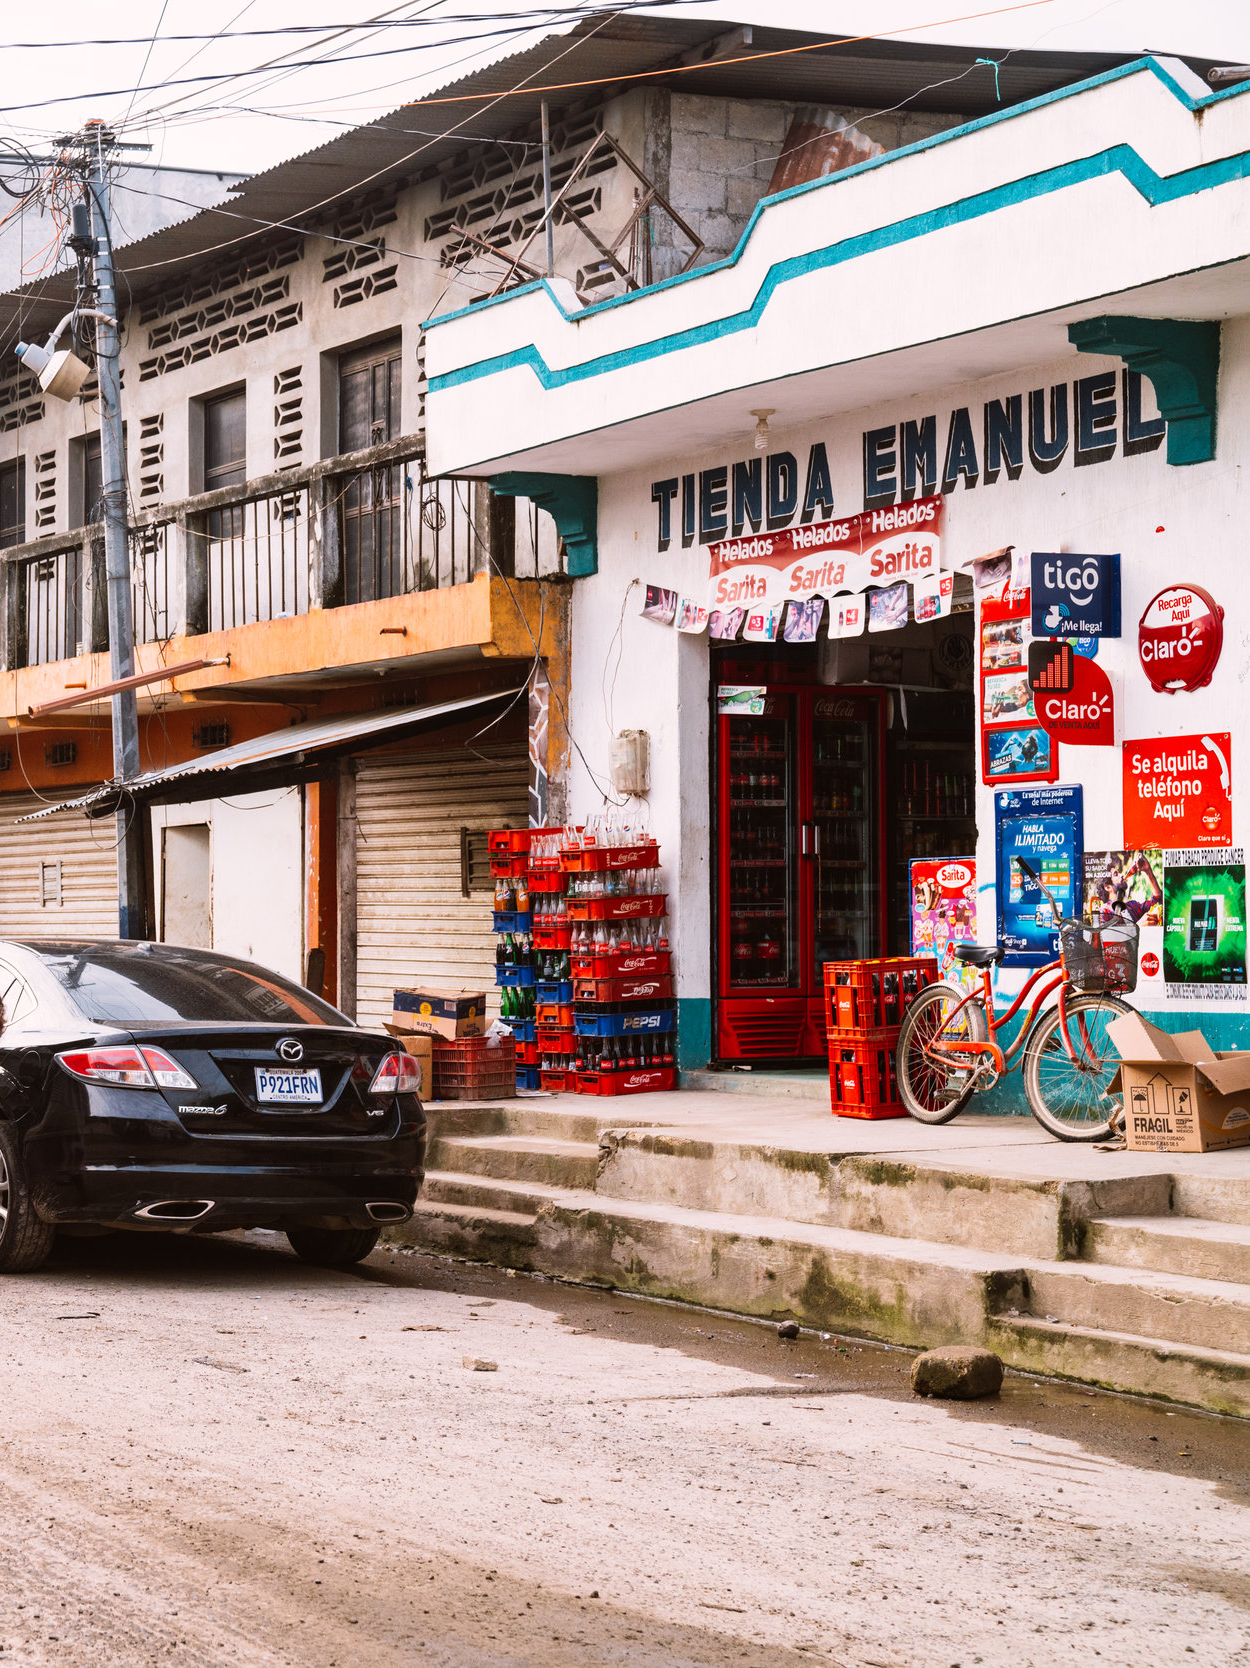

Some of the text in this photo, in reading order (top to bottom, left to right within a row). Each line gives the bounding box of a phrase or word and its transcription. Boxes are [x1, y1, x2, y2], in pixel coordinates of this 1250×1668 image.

[652, 368, 1167, 552] TIENDA EMANUEL
[719, 502, 935, 562] Helados Helados Helados
[715, 542, 933, 604] Sarita Sarita Sarita
[1043, 558, 1100, 591] tigo
[1158, 595, 1193, 612] Recarga
[1171, 606, 1191, 622] Aquí
[1061, 620, 1103, 634] ¡Me llega!
[1141, 638, 1192, 662] Claro
[1045, 699, 1101, 720] Claro
[1048, 719, 1101, 729] DE VENTA AQUÍ
[990, 754, 1012, 768] ABRAZAS
[1132, 750, 1208, 776] Se alquila
[1138, 775, 1202, 798] teléfono
[1153, 798, 1185, 822] Aquí
[1202, 815, 1218, 823] Claro
[1022, 825, 1044, 833] HABLA
[1015, 833, 1065, 846] ILIMITADO
[1032, 845, 1057, 854] y navega
[941, 869, 965, 881] Sarita
[623, 1015, 661, 1029] PEPSI
[260, 1075, 318, 1094] P921FRN
[1134, 1117, 1173, 1133] FRAGIL
